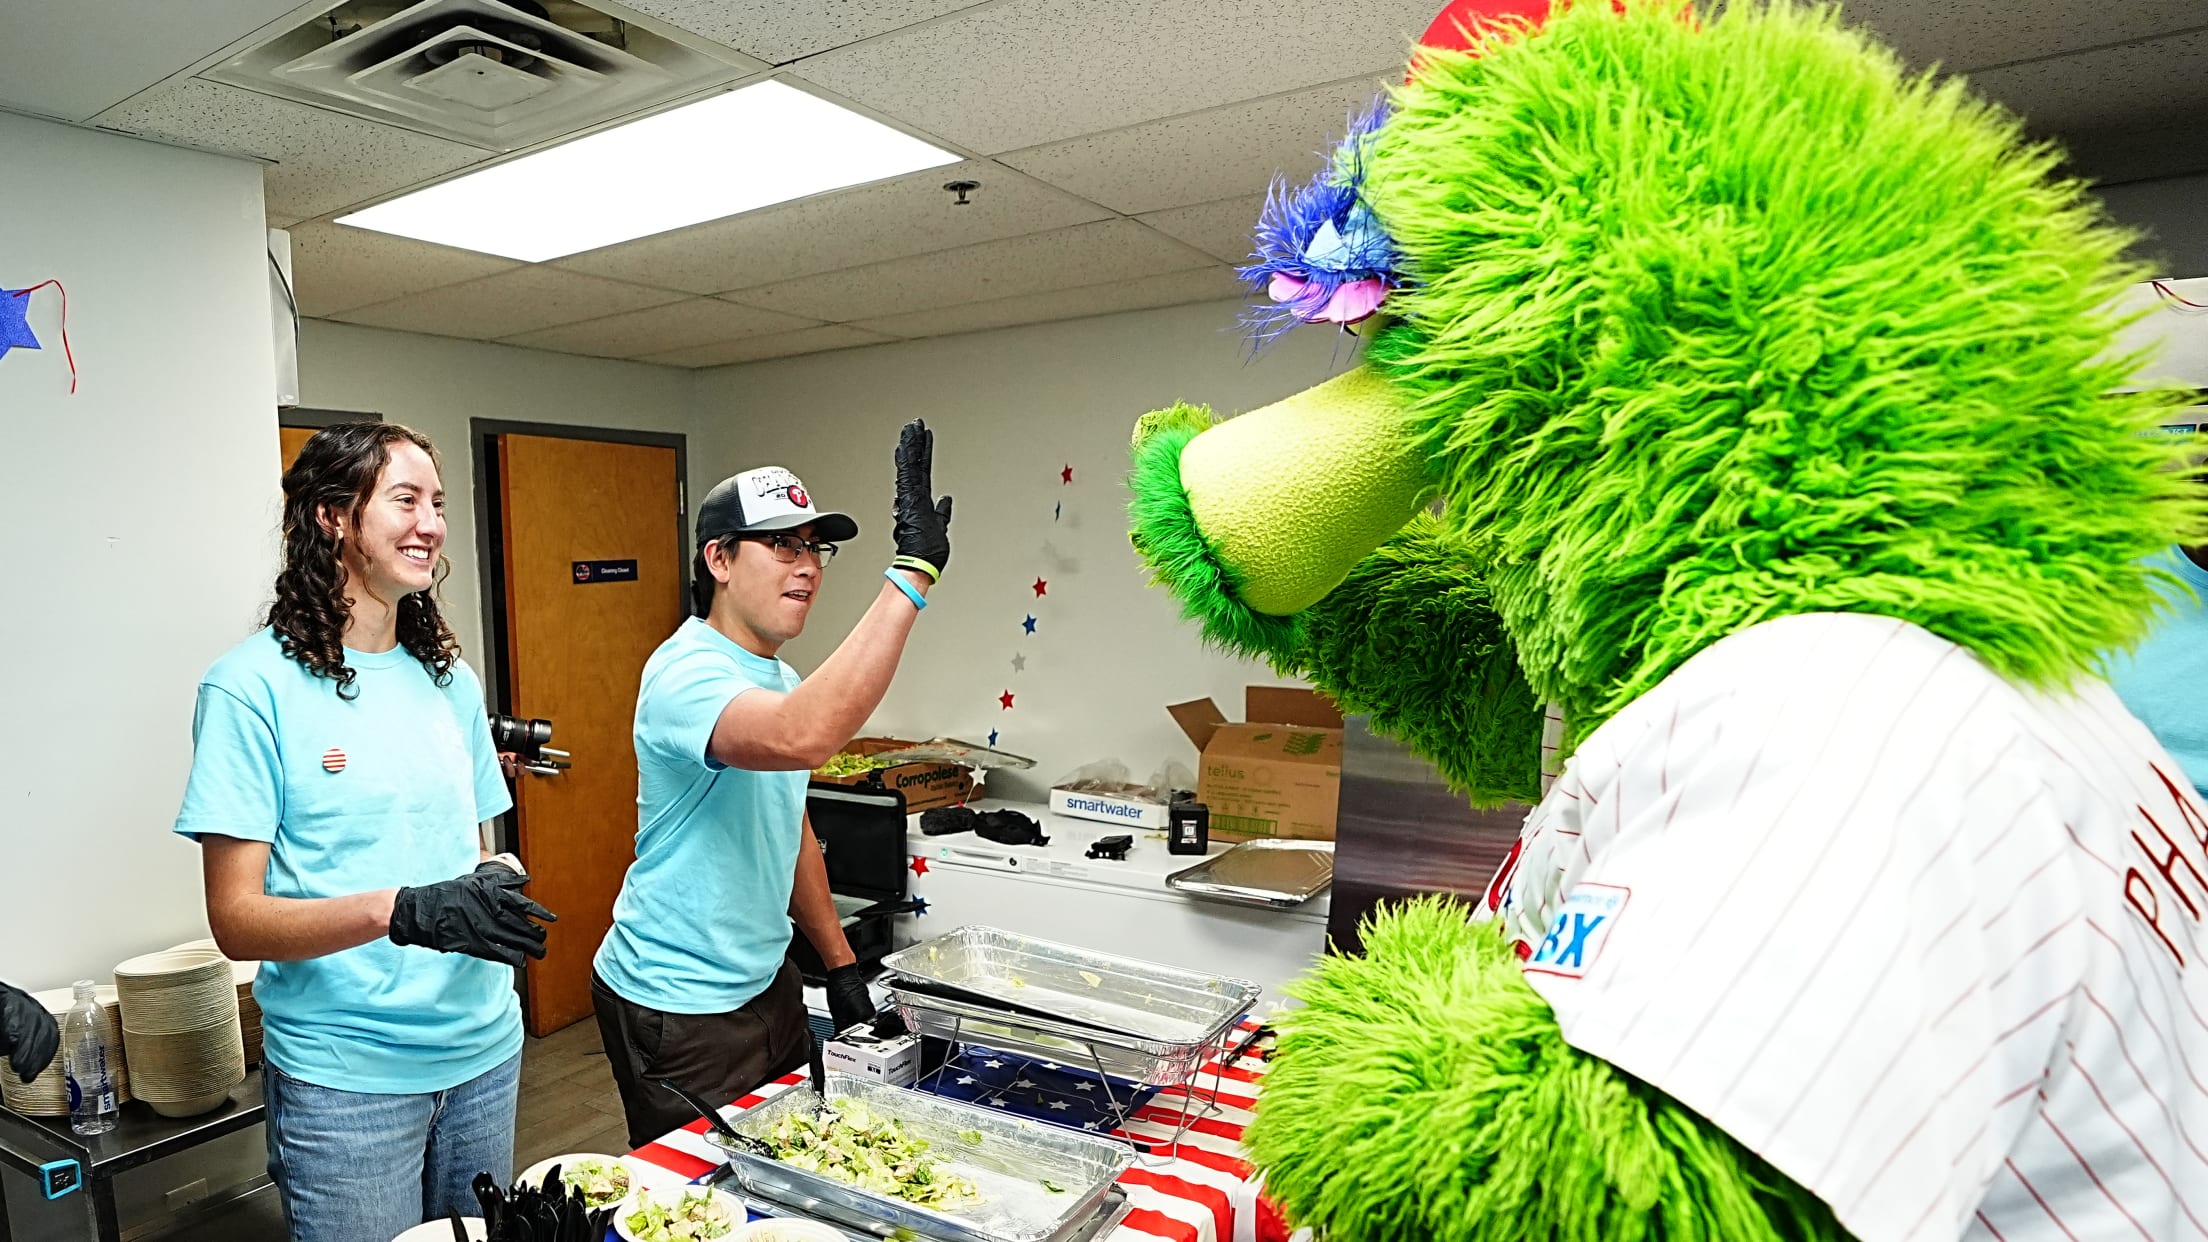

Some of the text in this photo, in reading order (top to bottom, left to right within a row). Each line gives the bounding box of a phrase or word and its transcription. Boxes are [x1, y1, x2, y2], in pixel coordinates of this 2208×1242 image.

[895, 765, 959, 789] Corropolese
[1207, 765, 1245, 779] tellus
[1066, 797, 1143, 819] smartwater
[827, 1049, 857, 1063] TouchFlex
[98, 1045, 111, 1111] smartwater
